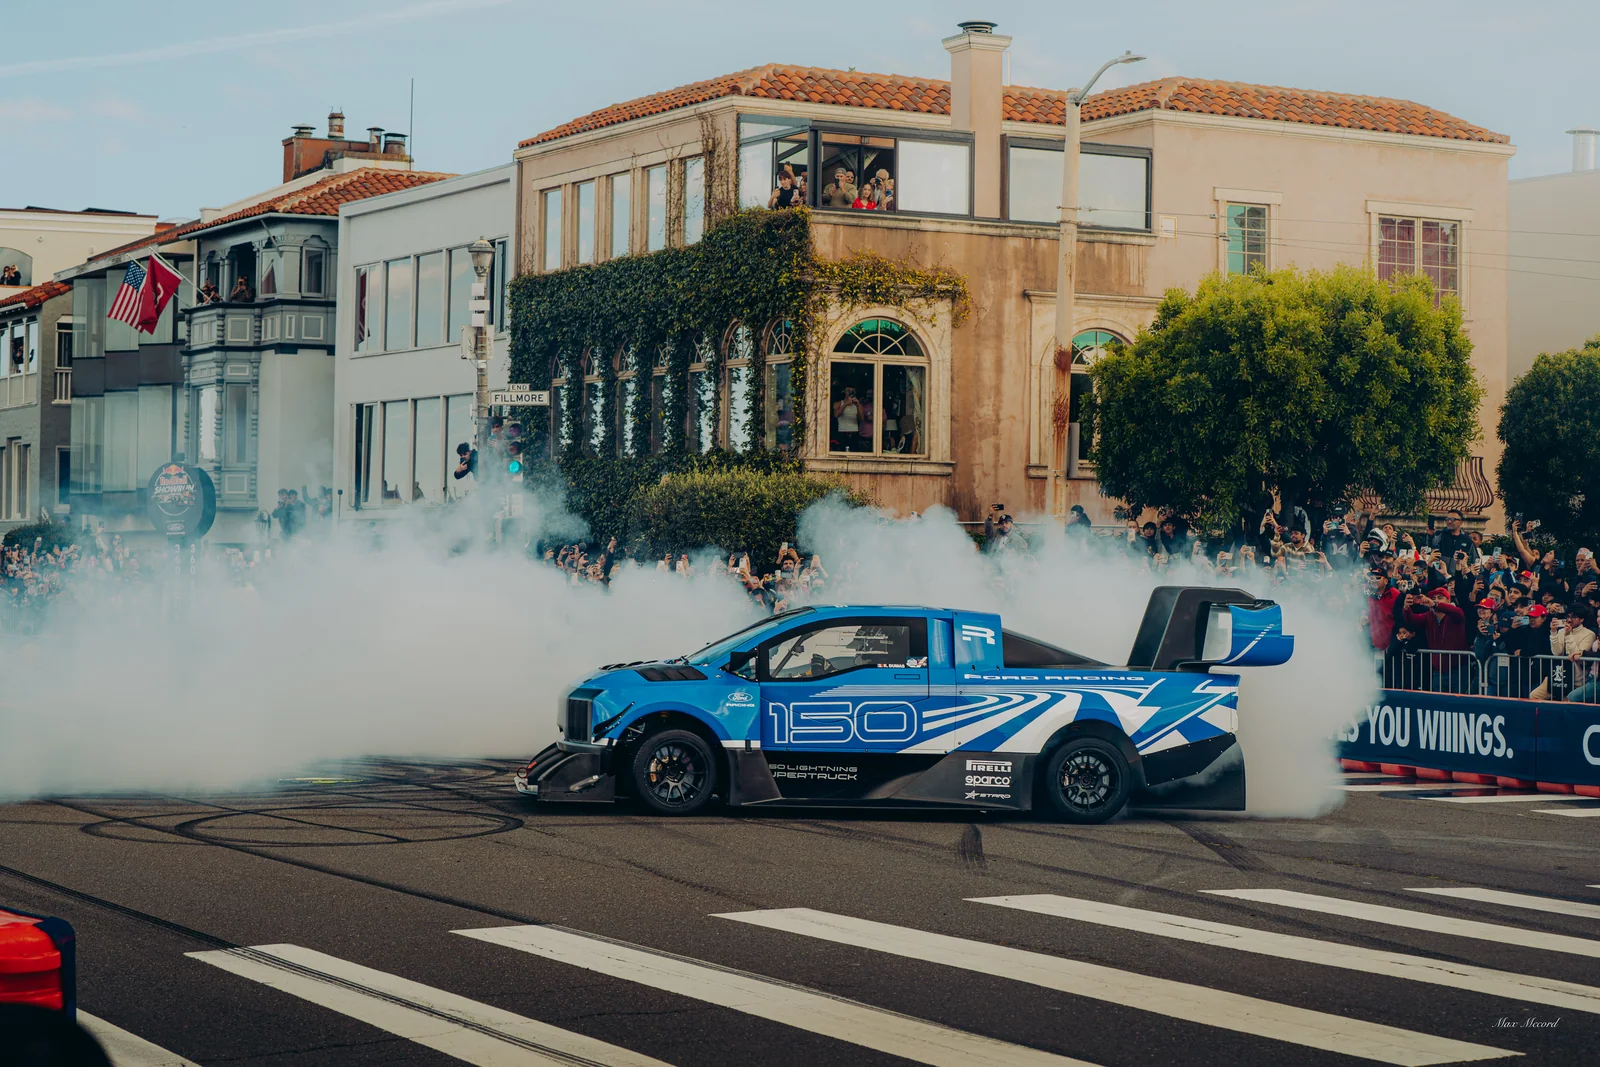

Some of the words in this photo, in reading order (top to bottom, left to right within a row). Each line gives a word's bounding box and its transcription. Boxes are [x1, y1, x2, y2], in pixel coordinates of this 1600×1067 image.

[494, 394, 544, 403] FILLMORE
[964, 673, 1039, 681] FORD
[769, 701, 918, 744] 150
[1366, 705, 1411, 748] YOU
[1416, 708, 1514, 759] WIIINGS.
[966, 759, 1012, 772] PIRELLI
[965, 775, 1011, 787] sparco
